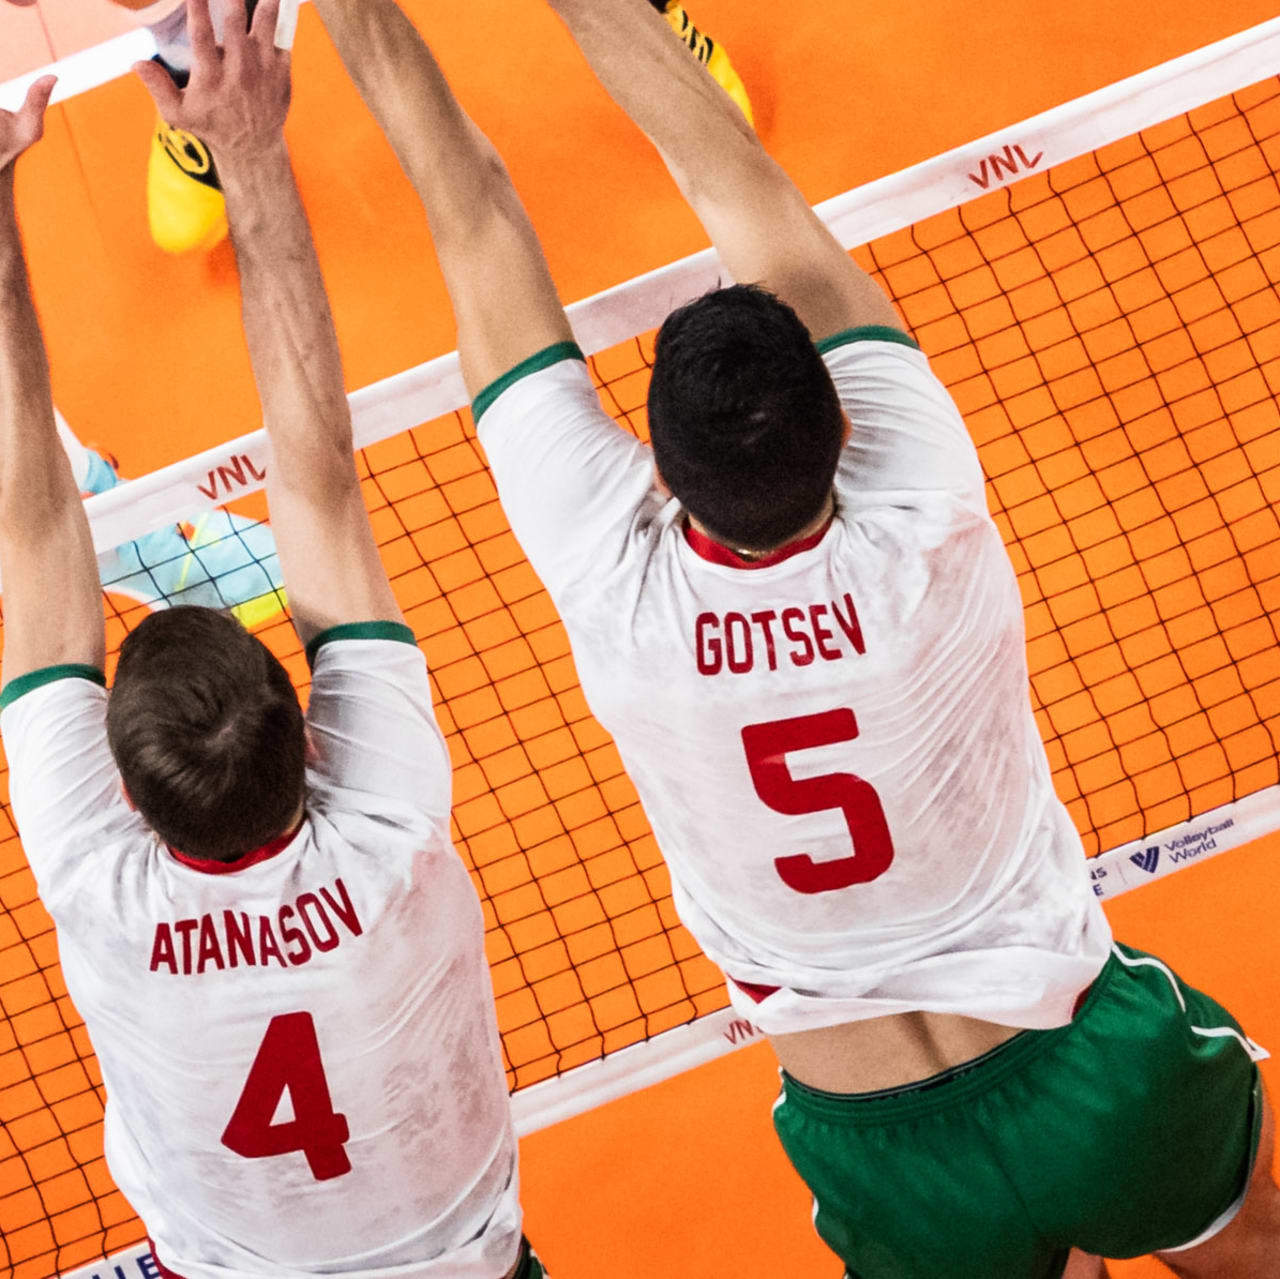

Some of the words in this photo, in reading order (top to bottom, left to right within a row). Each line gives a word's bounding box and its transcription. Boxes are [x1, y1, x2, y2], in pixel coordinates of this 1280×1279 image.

[967, 144, 1044, 190] VNL
[197, 454, 267, 500] VNL
[695, 593, 867, 677] GOTSEV
[740, 706, 896, 895] 5
[1164, 818, 1235, 852] Volleyball
[1168, 837, 1217, 864] World
[149, 878, 363, 976] ATANASOV
[220, 1010, 353, 1182] 4
